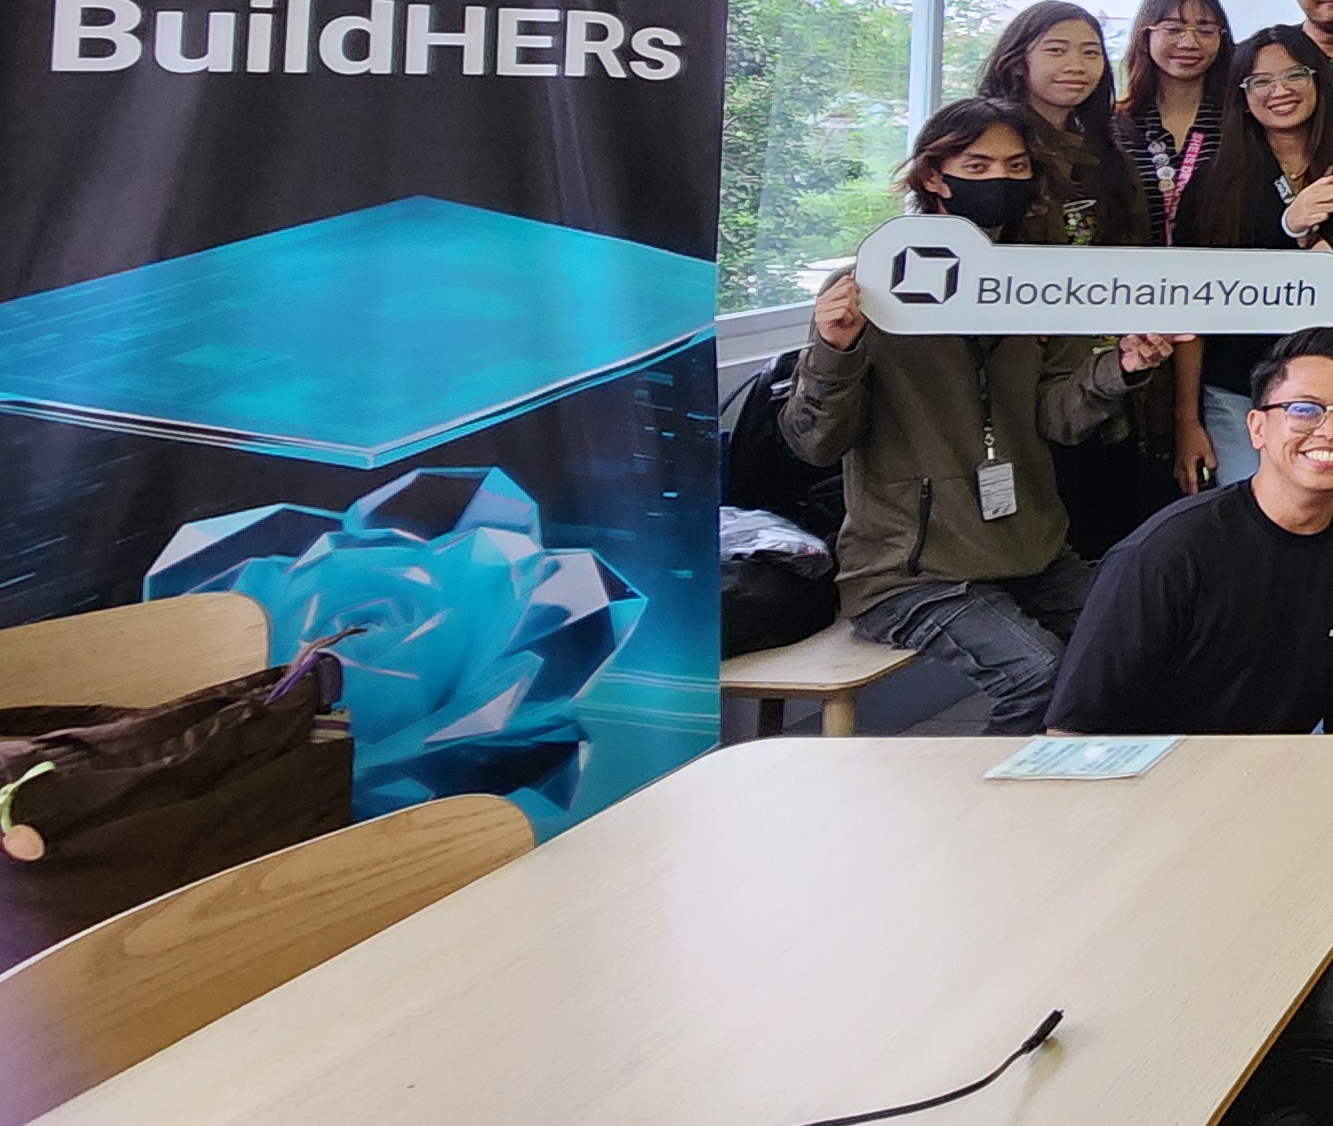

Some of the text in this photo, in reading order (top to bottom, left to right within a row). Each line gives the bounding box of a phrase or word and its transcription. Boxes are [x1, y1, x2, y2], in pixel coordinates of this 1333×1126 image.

[1185, 131, 1205, 154] SHE
[1182, 153, 1199, 166] IS
[976, 276, 1317, 307] Blockchain4Youth
